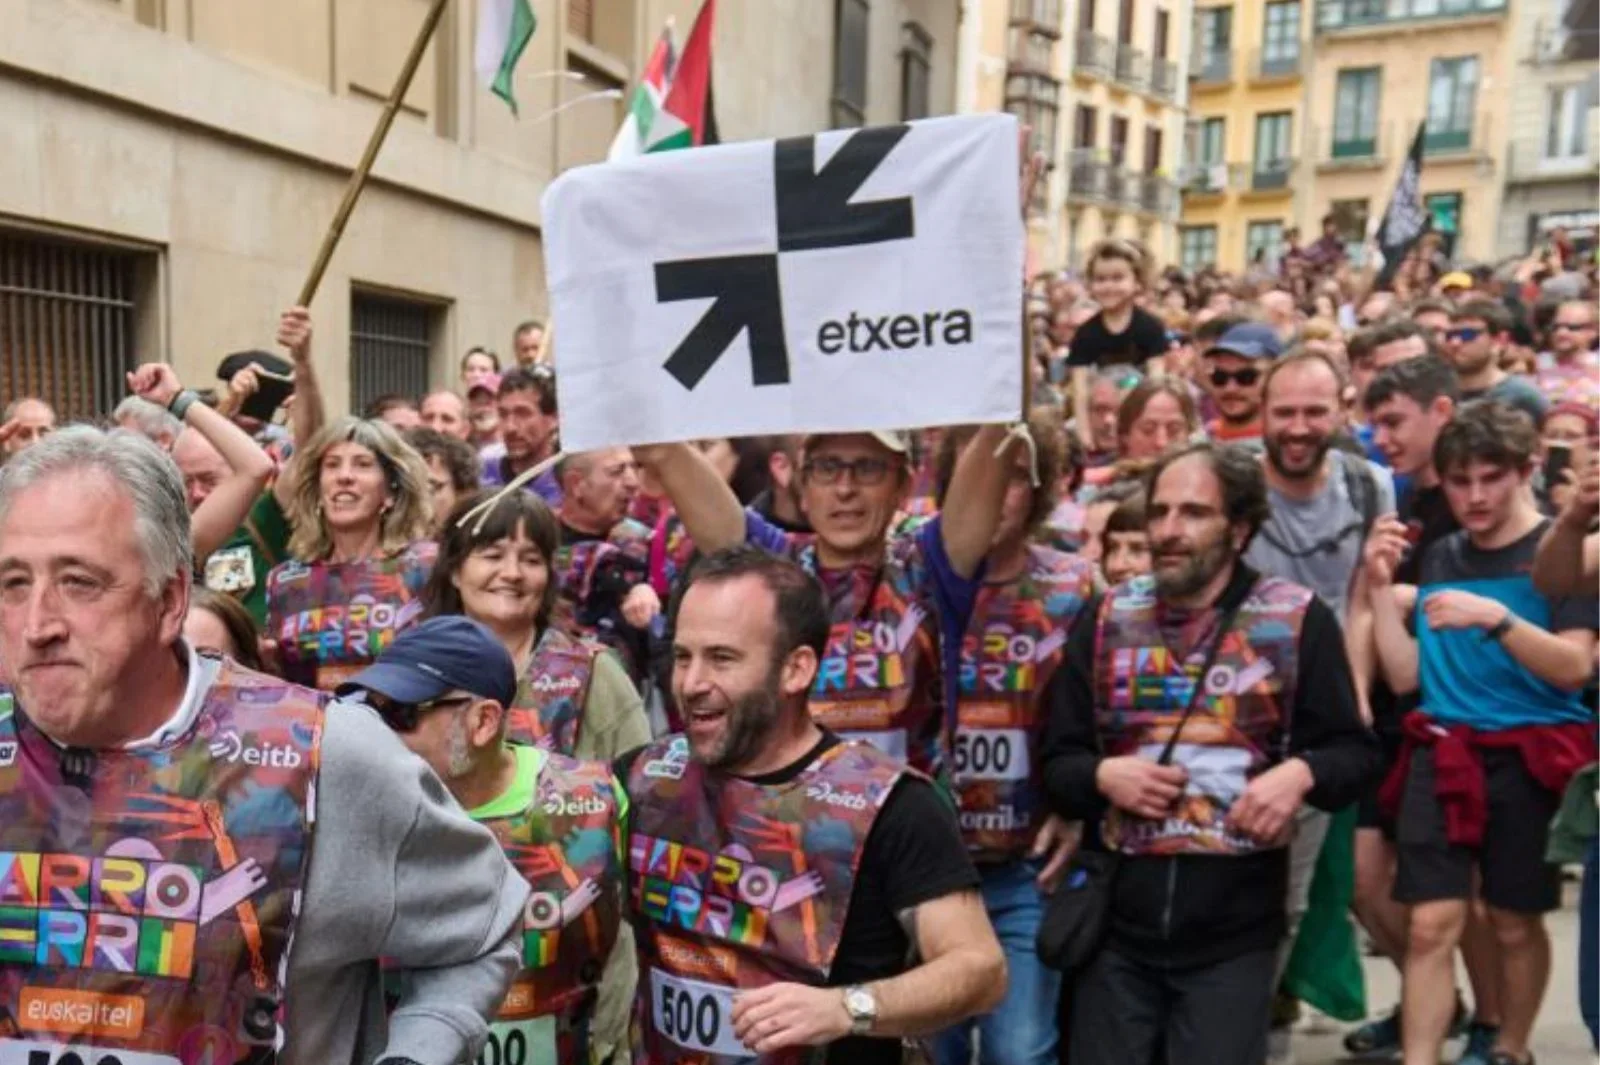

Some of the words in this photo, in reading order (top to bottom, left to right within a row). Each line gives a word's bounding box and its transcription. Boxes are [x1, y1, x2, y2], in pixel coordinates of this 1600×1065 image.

[817, 309, 973, 355] etxera
[242, 741, 302, 768] eitb
[953, 733, 1012, 773] 500
[567, 796, 607, 815] eitb
[27, 998, 135, 1028] euskaltel
[661, 984, 721, 1047] 500
[481, 1029, 527, 1065] 00
